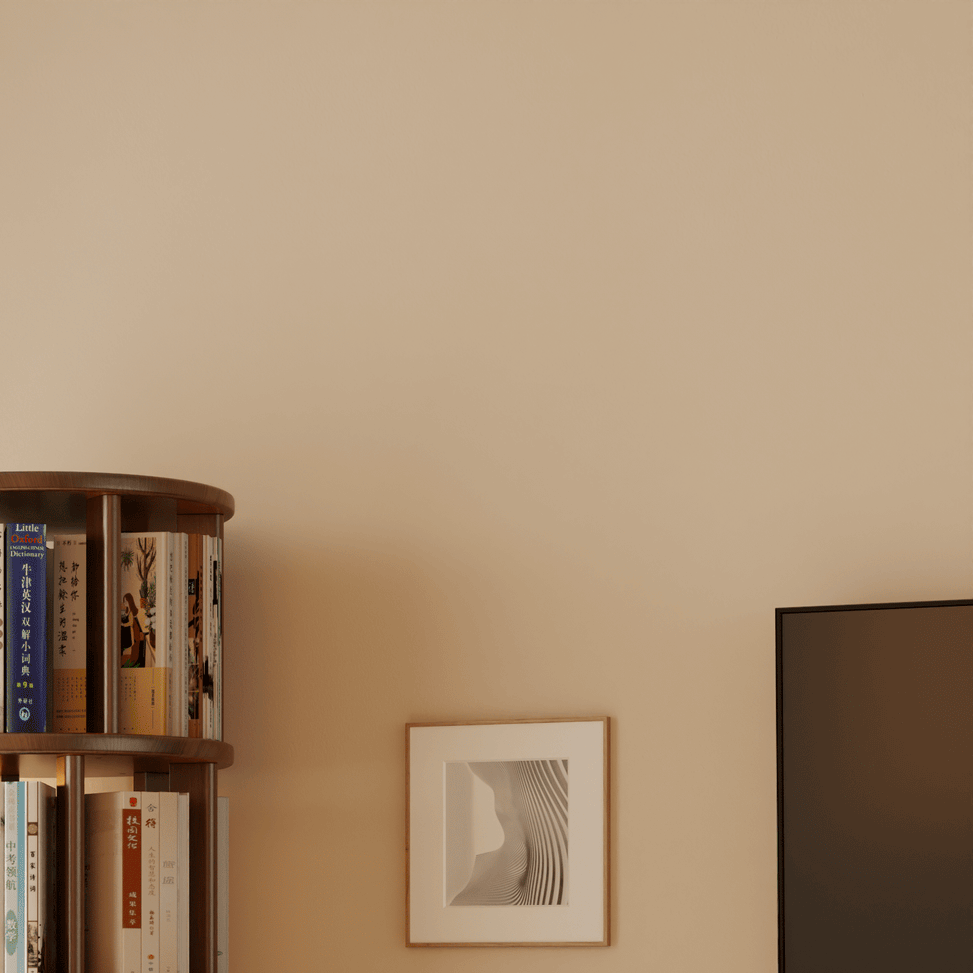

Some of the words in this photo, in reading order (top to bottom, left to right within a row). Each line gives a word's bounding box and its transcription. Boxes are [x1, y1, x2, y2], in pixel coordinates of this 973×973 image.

[15, 524, 39, 533] Little
[10, 534, 43, 544] Oxford
[10, 551, 45, 559] Dictionary
[21, 563, 32, 676] 牛津英汉双解小词典
